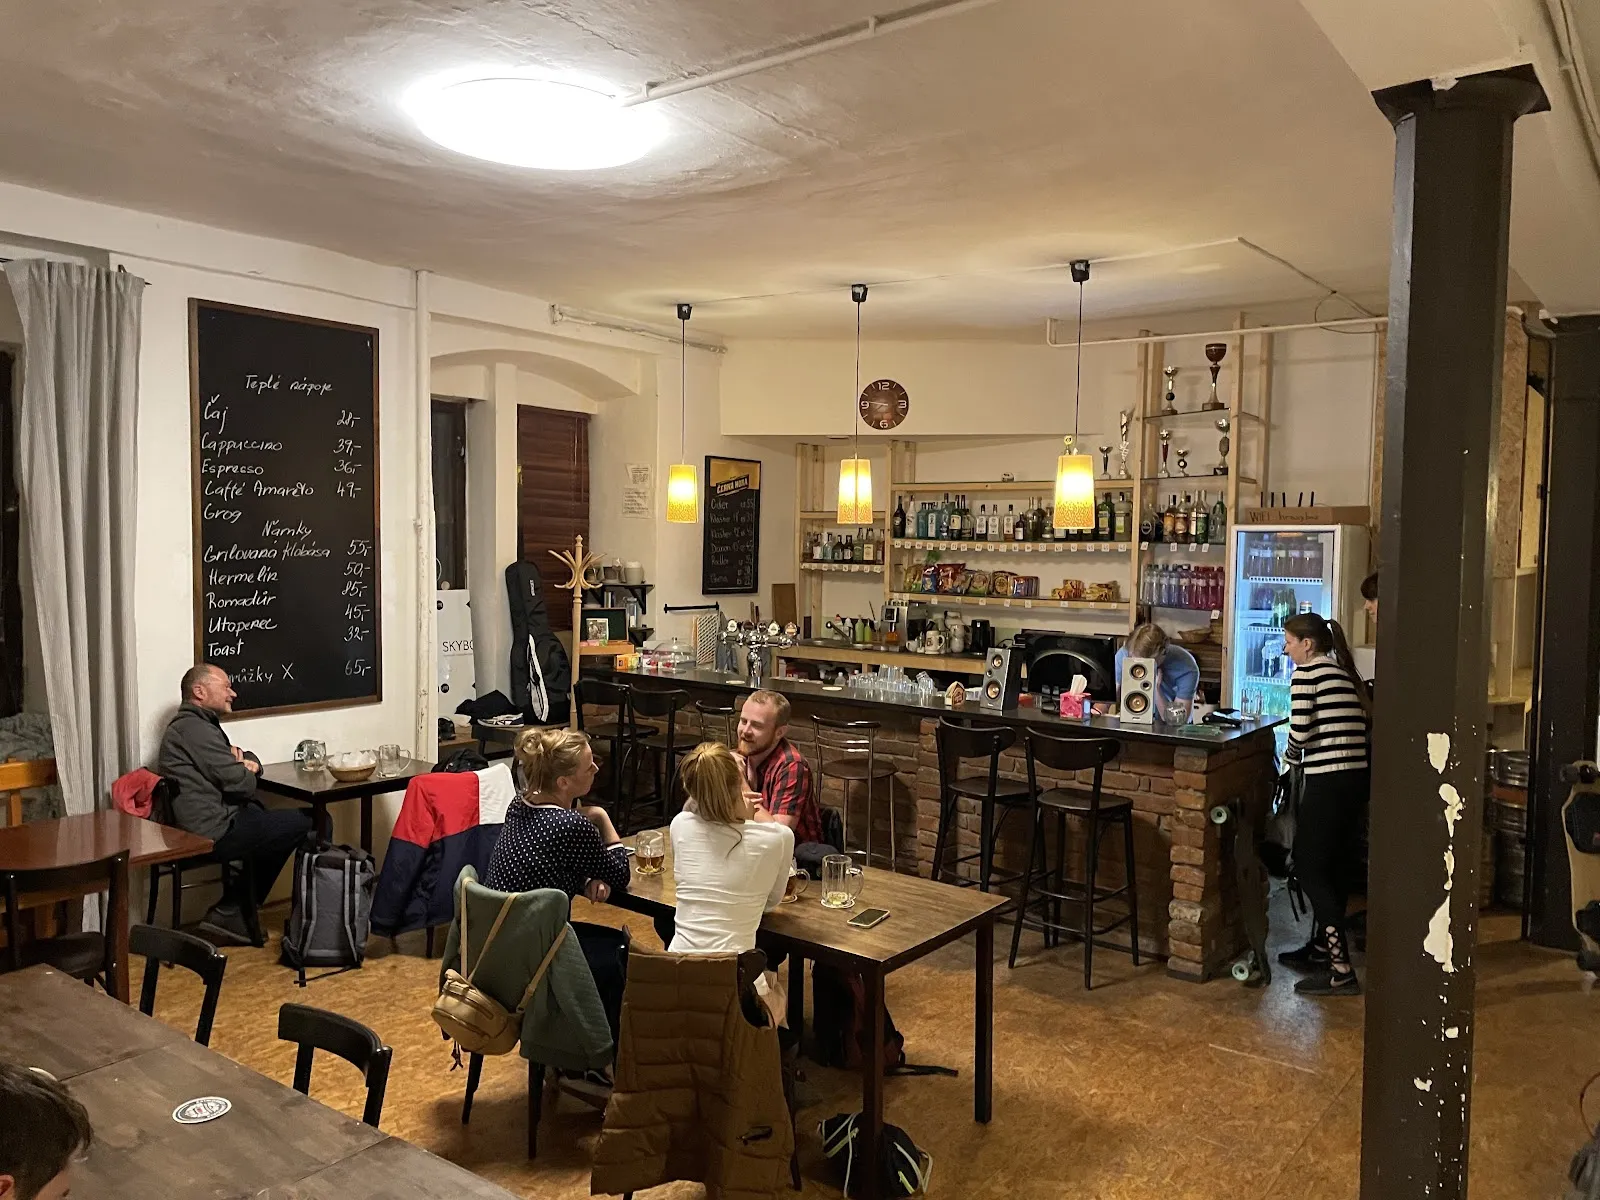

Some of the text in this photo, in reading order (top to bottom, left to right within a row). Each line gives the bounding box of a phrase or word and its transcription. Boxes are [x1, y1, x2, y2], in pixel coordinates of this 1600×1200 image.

[245, 373, 333, 395] Teplé nápoje
[877, 381, 890, 390] 12
[204, 394, 229, 434] Čaj
[860, 400, 870, 409] 9
[897, 400, 907, 409] 3
[879, 419, 889, 429] 6
[201, 431, 283, 457] Cappuccino
[201, 458, 264, 478] Espresso
[203, 502, 242, 524] Grog
[204, 540, 278, 563] Grilovaná
[207, 637, 244, 657] Toast
[281, 661, 294, 680] X
